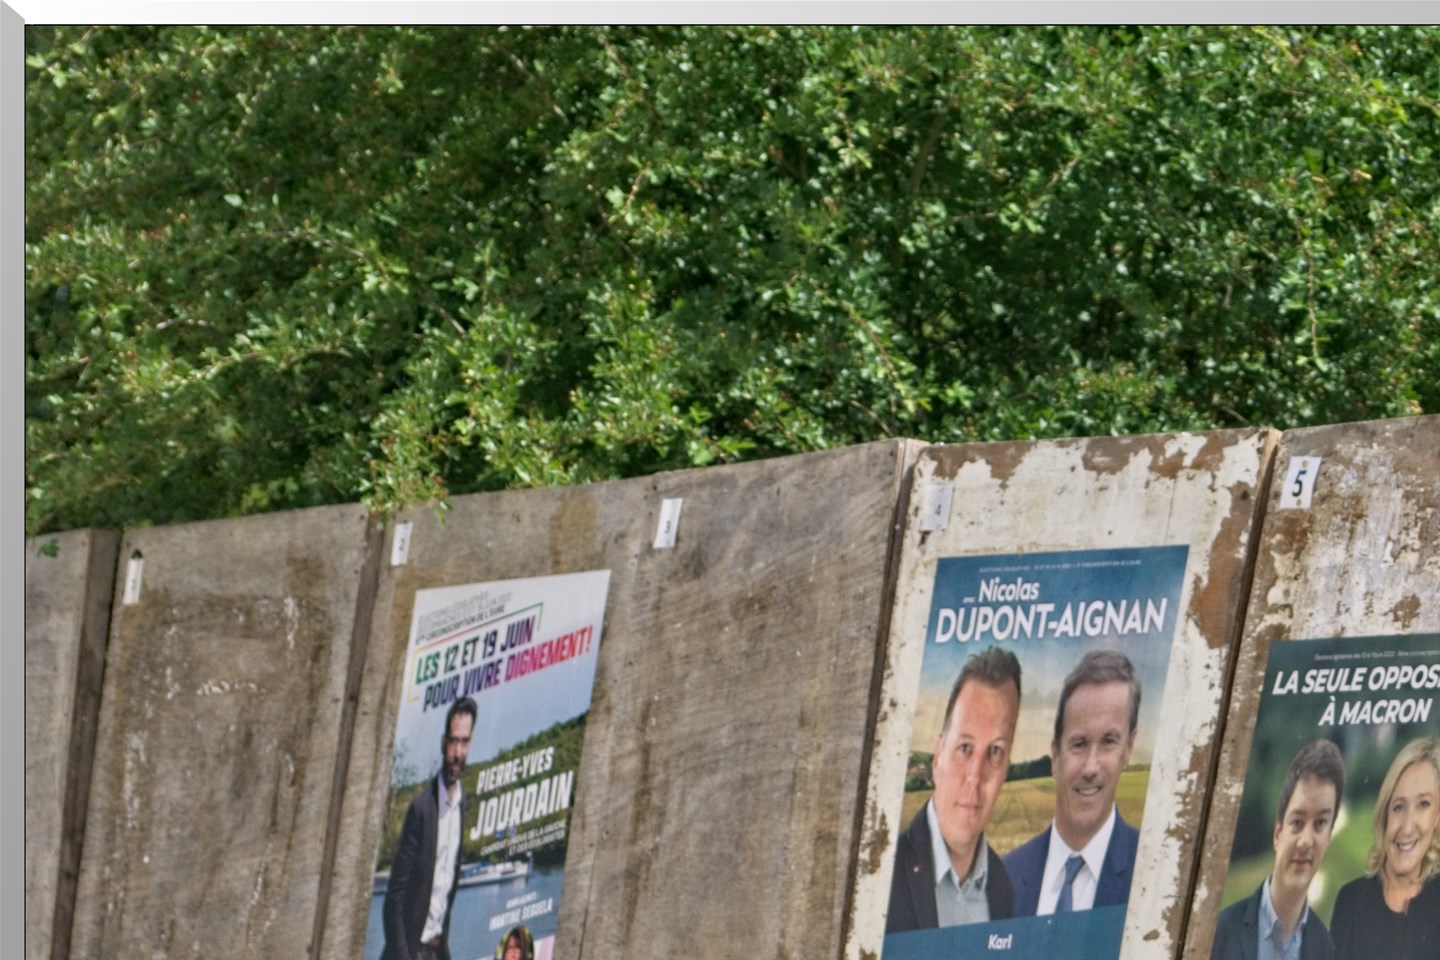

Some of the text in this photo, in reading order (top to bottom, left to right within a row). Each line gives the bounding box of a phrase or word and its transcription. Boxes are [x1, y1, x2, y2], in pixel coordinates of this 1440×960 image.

[1292, 470, 1307, 497] 5
[978, 576, 1041, 603] Nicolas
[934, 597, 1168, 644] DUPONT-AIGNAN
[415, 615, 536, 685] LES 12 ET 19 JUIN
[423, 672, 461, 713] POUR
[462, 658, 503, 698] VIVRE
[1271, 670, 1299, 695] LA
[1301, 667, 1368, 694] SEULE
[1318, 696, 1433, 727] À MACRON
[476, 746, 555, 795] PIERRE-YVES
[469, 769, 574, 841] JOURDAIN
[988, 934, 1013, 950] Karl
